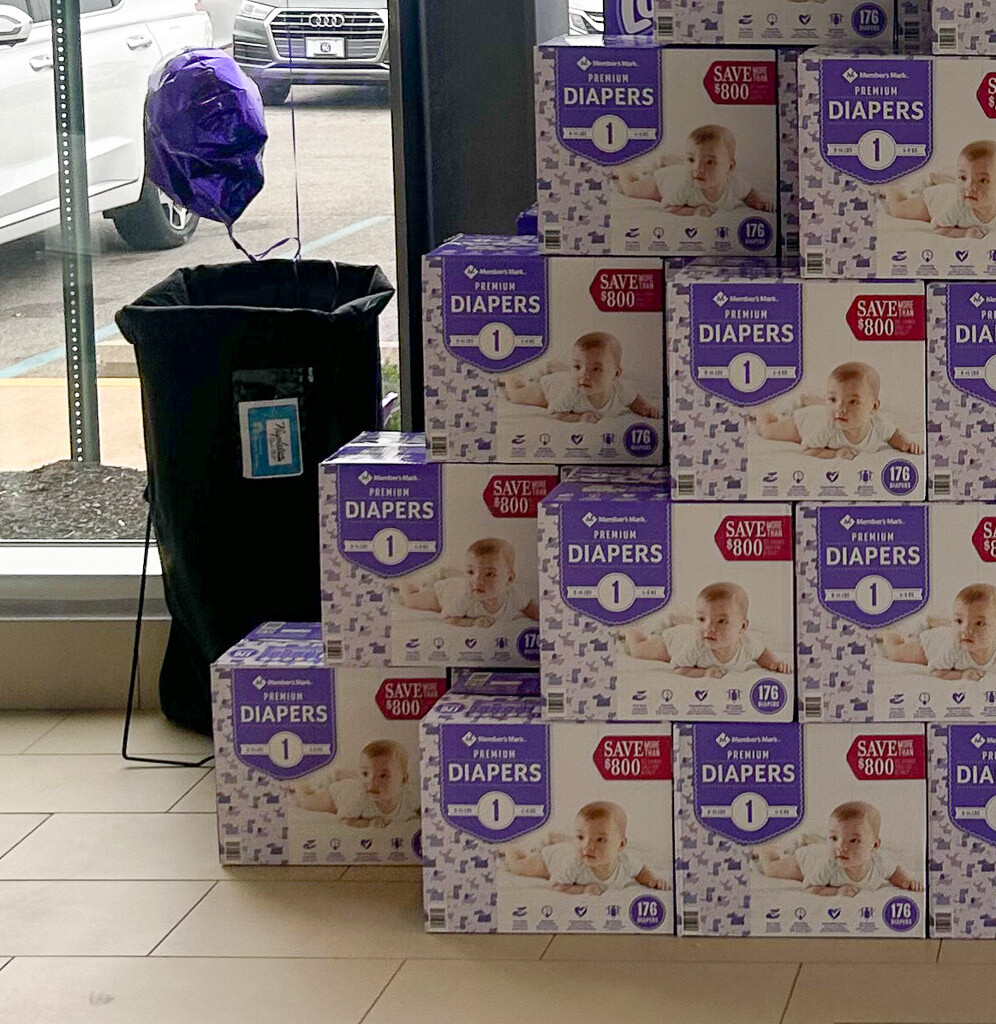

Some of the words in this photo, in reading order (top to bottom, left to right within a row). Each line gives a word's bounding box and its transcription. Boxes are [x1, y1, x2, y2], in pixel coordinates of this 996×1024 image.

[713, 65, 752, 82] SAVE
[564, 86, 654, 106] DIAPERS
[714, 82, 749, 100] $800
[854, 85, 898, 96] PREMIUM
[829, 100, 924, 120] DIAPERS
[872, 137, 880, 162] 1
[599, 273, 638, 290] SAVE
[451, 294, 541, 314] DIAPERS
[600, 290, 635, 308] $800
[857, 299, 898, 317] SAVE
[724, 309, 768, 319] PREMIUM
[699, 323, 794, 343] DIAPERS
[857, 317, 894, 337] $800
[743, 360, 751, 385] 1
[889, 466, 911, 482] 176
[493, 479, 531, 496] SAVE
[345, 500, 434, 519] DIAPERS
[493, 496, 528, 514] $800
[725, 520, 766, 538] SAVE
[851, 531, 894, 542] PREMIUM
[568, 543, 663, 563] DIAPERS
[725, 538, 763, 557] $800
[826, 545, 921, 566] DIAPERS
[870, 582, 877, 607] 1
[385, 682, 423, 699] SAVE
[241, 704, 328, 723] DIAPERS
[385, 699, 420, 716] $800
[473, 749, 516, 759] PREMIUM
[604, 740, 644, 757] SAVE
[857, 740, 897, 758] SAVE
[448, 763, 542, 782] DIAPERS
[604, 758, 641, 776] $800
[702, 763, 795, 783] DIAPERS
[857, 758, 894, 777] $800
[492, 798, 499, 822] 1
[637, 901, 658, 917] 176
